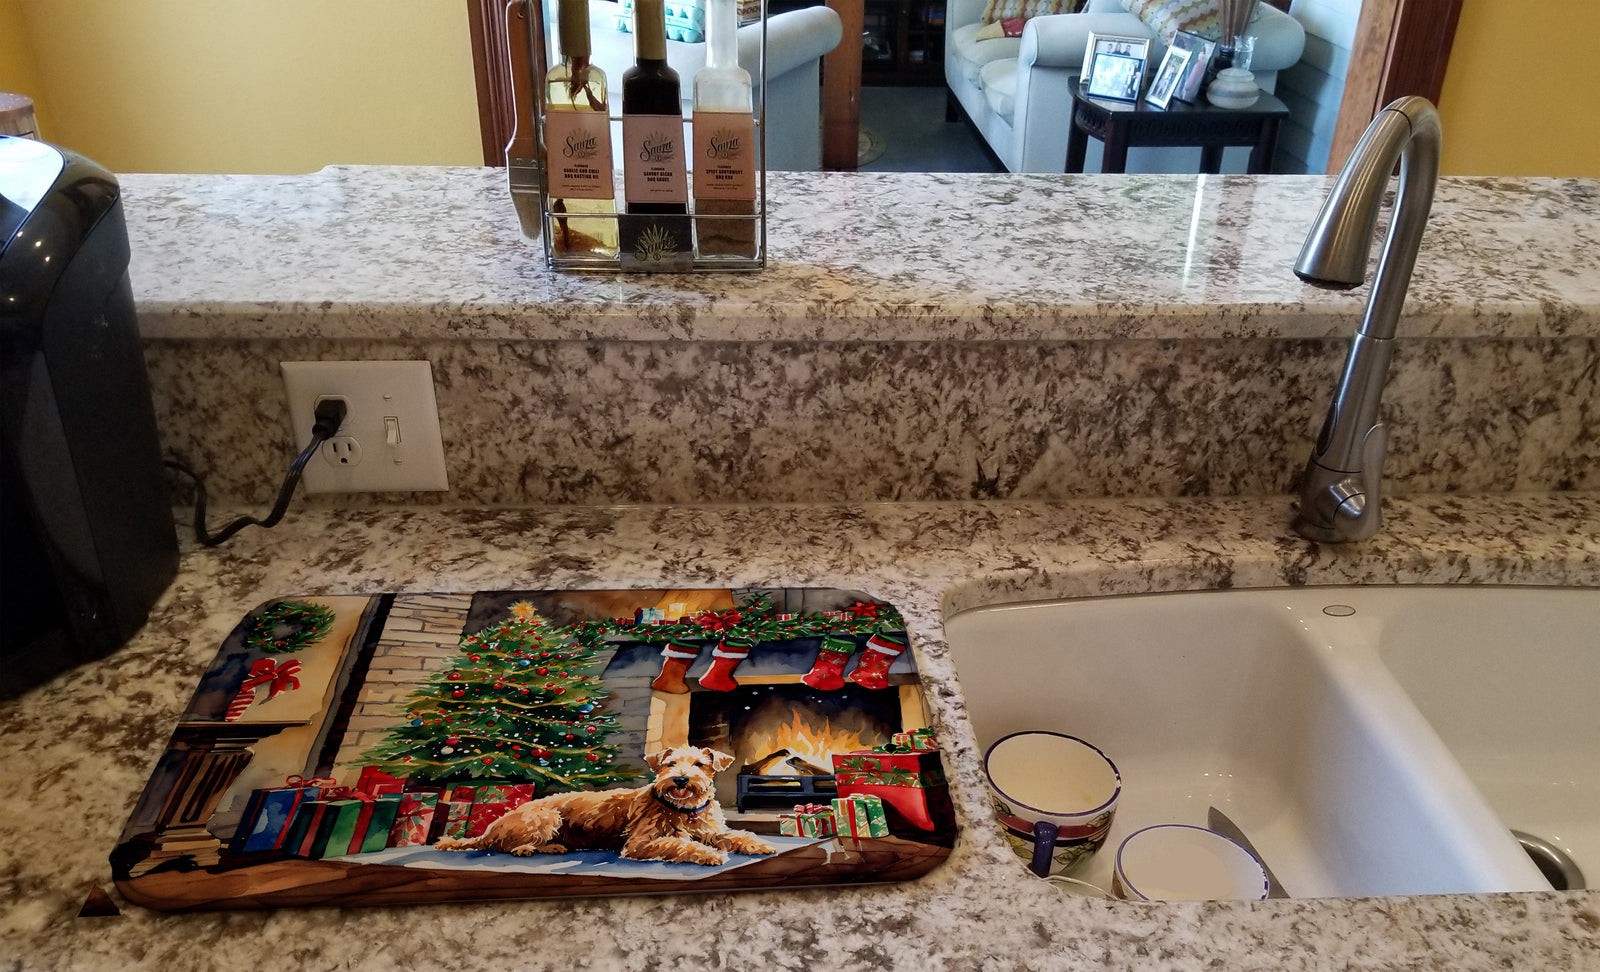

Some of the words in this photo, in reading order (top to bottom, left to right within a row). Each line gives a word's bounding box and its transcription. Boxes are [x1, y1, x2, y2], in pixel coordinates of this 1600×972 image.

[563, 136, 597, 158] Sauza
[640, 140, 674, 161] Sauza
[707, 137, 739, 158] Sauza
